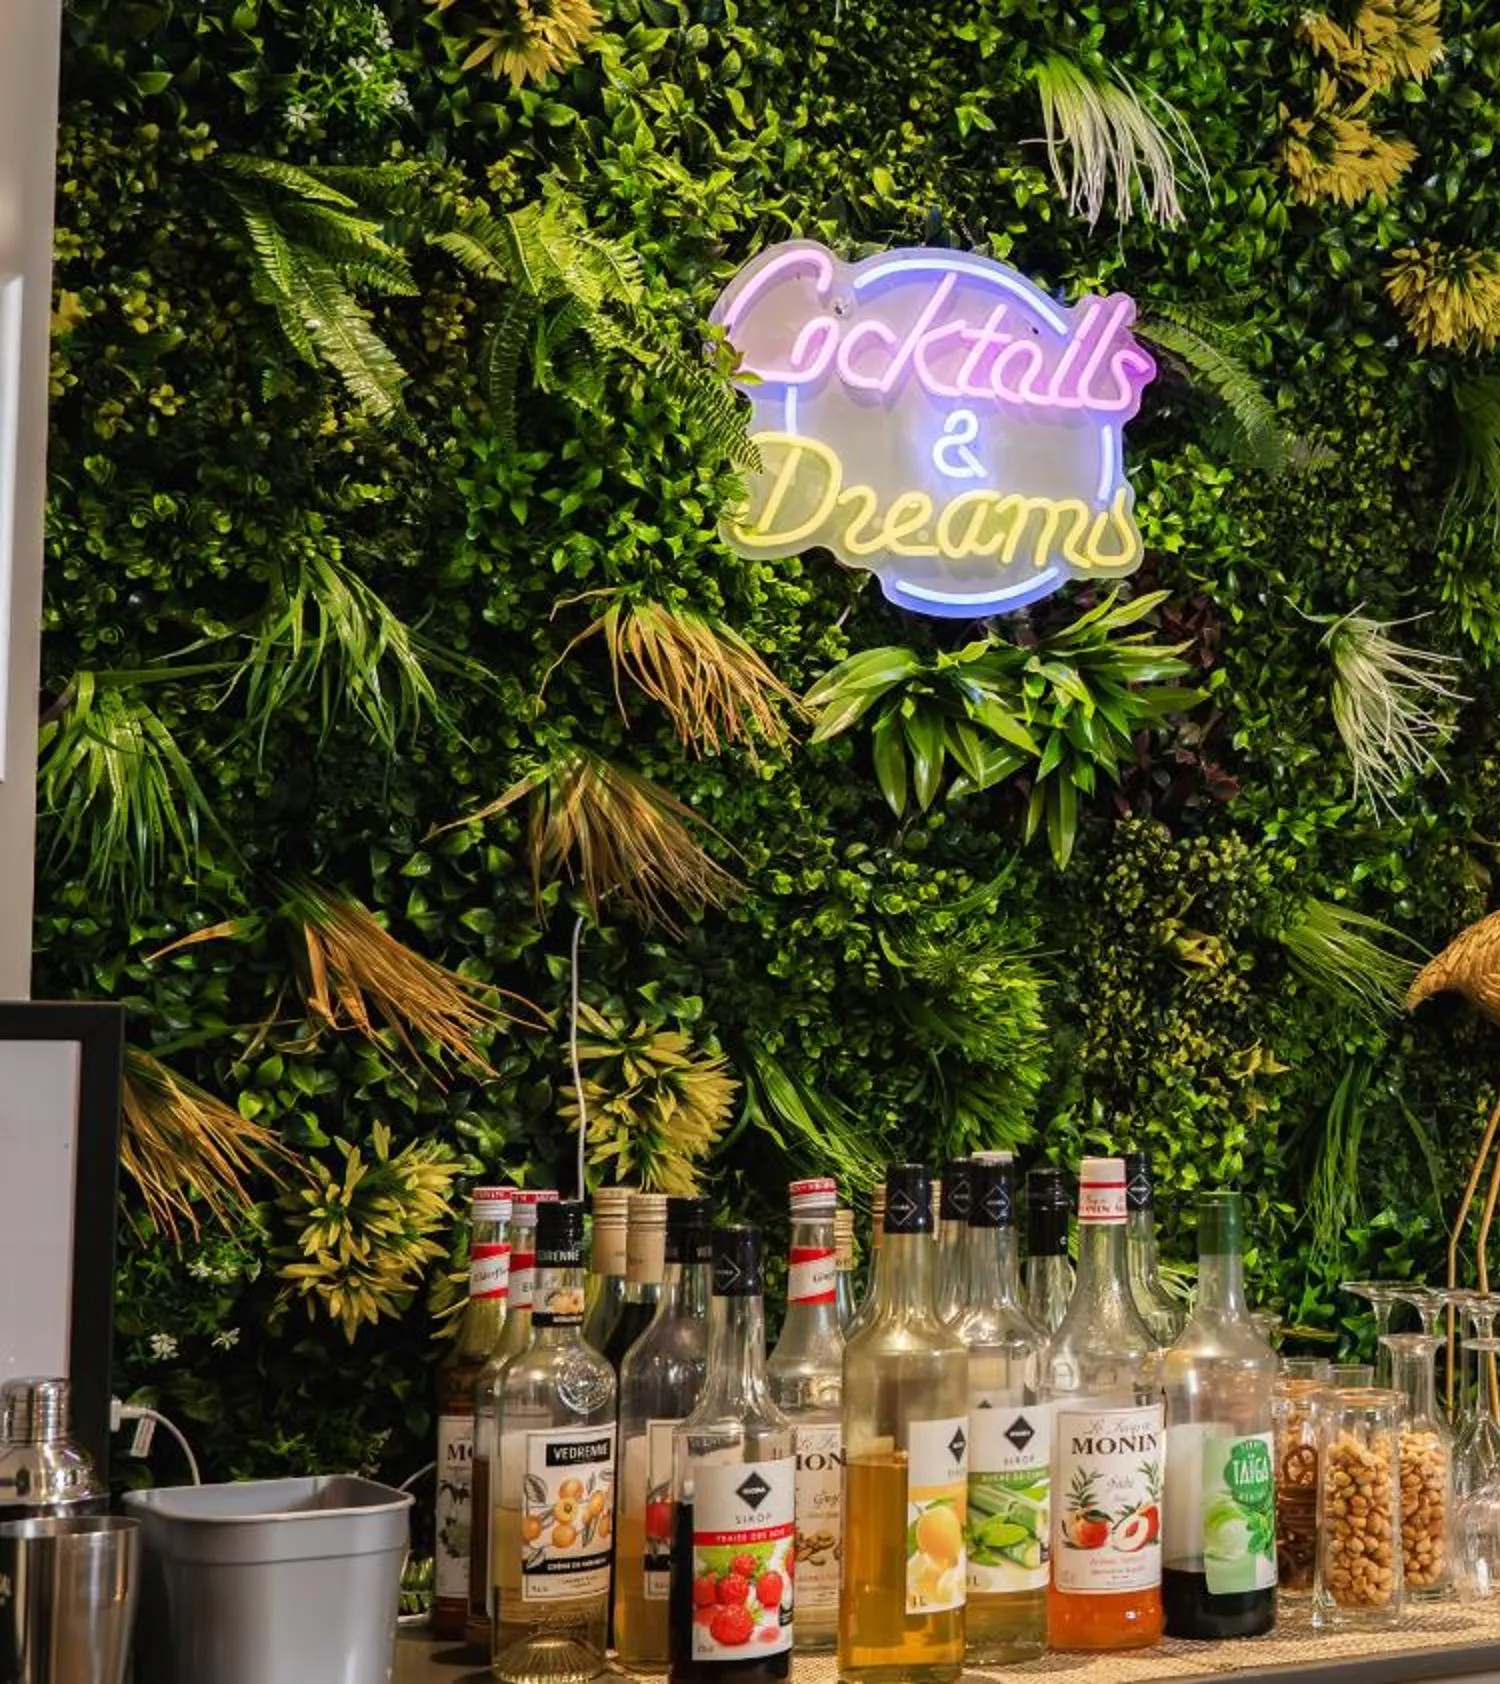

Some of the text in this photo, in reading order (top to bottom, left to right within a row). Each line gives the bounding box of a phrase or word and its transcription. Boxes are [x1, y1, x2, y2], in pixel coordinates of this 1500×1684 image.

[725, 249, 1157, 411] Cocktails
[733, 431, 1138, 568] Dreams
[932, 409, 989, 479] &
